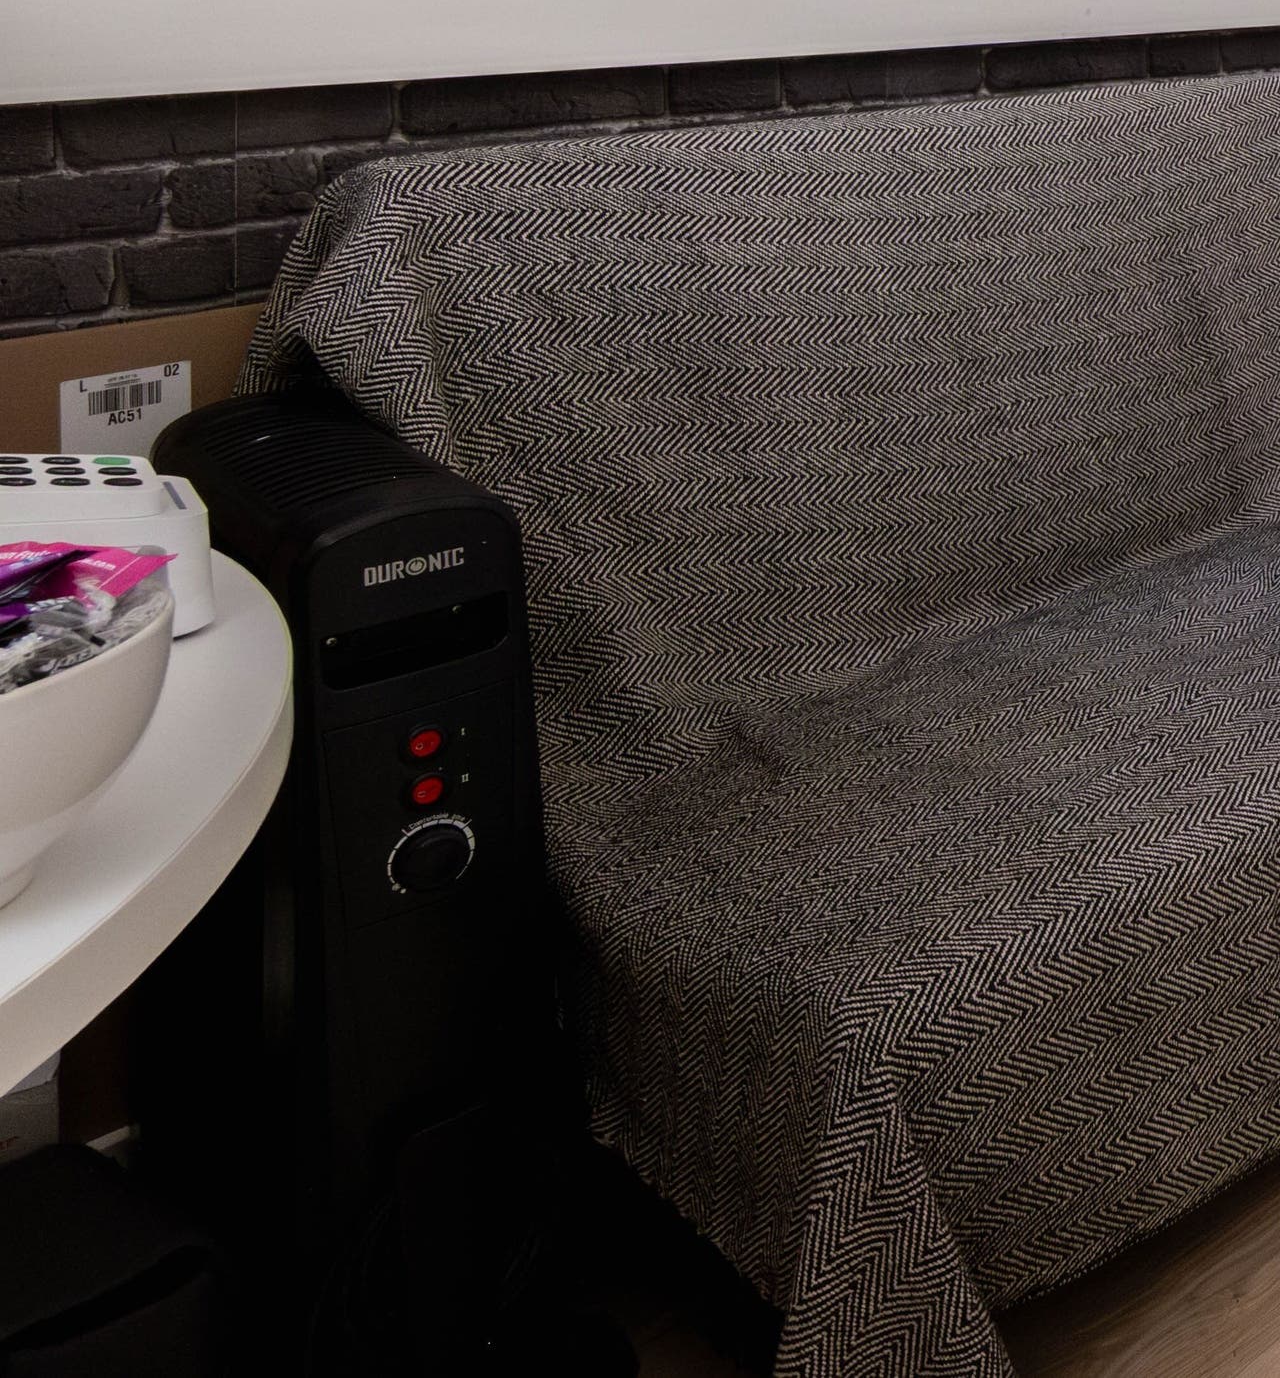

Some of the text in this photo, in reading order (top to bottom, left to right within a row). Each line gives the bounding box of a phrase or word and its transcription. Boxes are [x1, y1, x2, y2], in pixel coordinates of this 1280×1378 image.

[163, 363, 180, 378] 02
[79, 380, 88, 393] L
[108, 408, 142, 426] AC51
[363, 547, 465, 587] DURONIC
